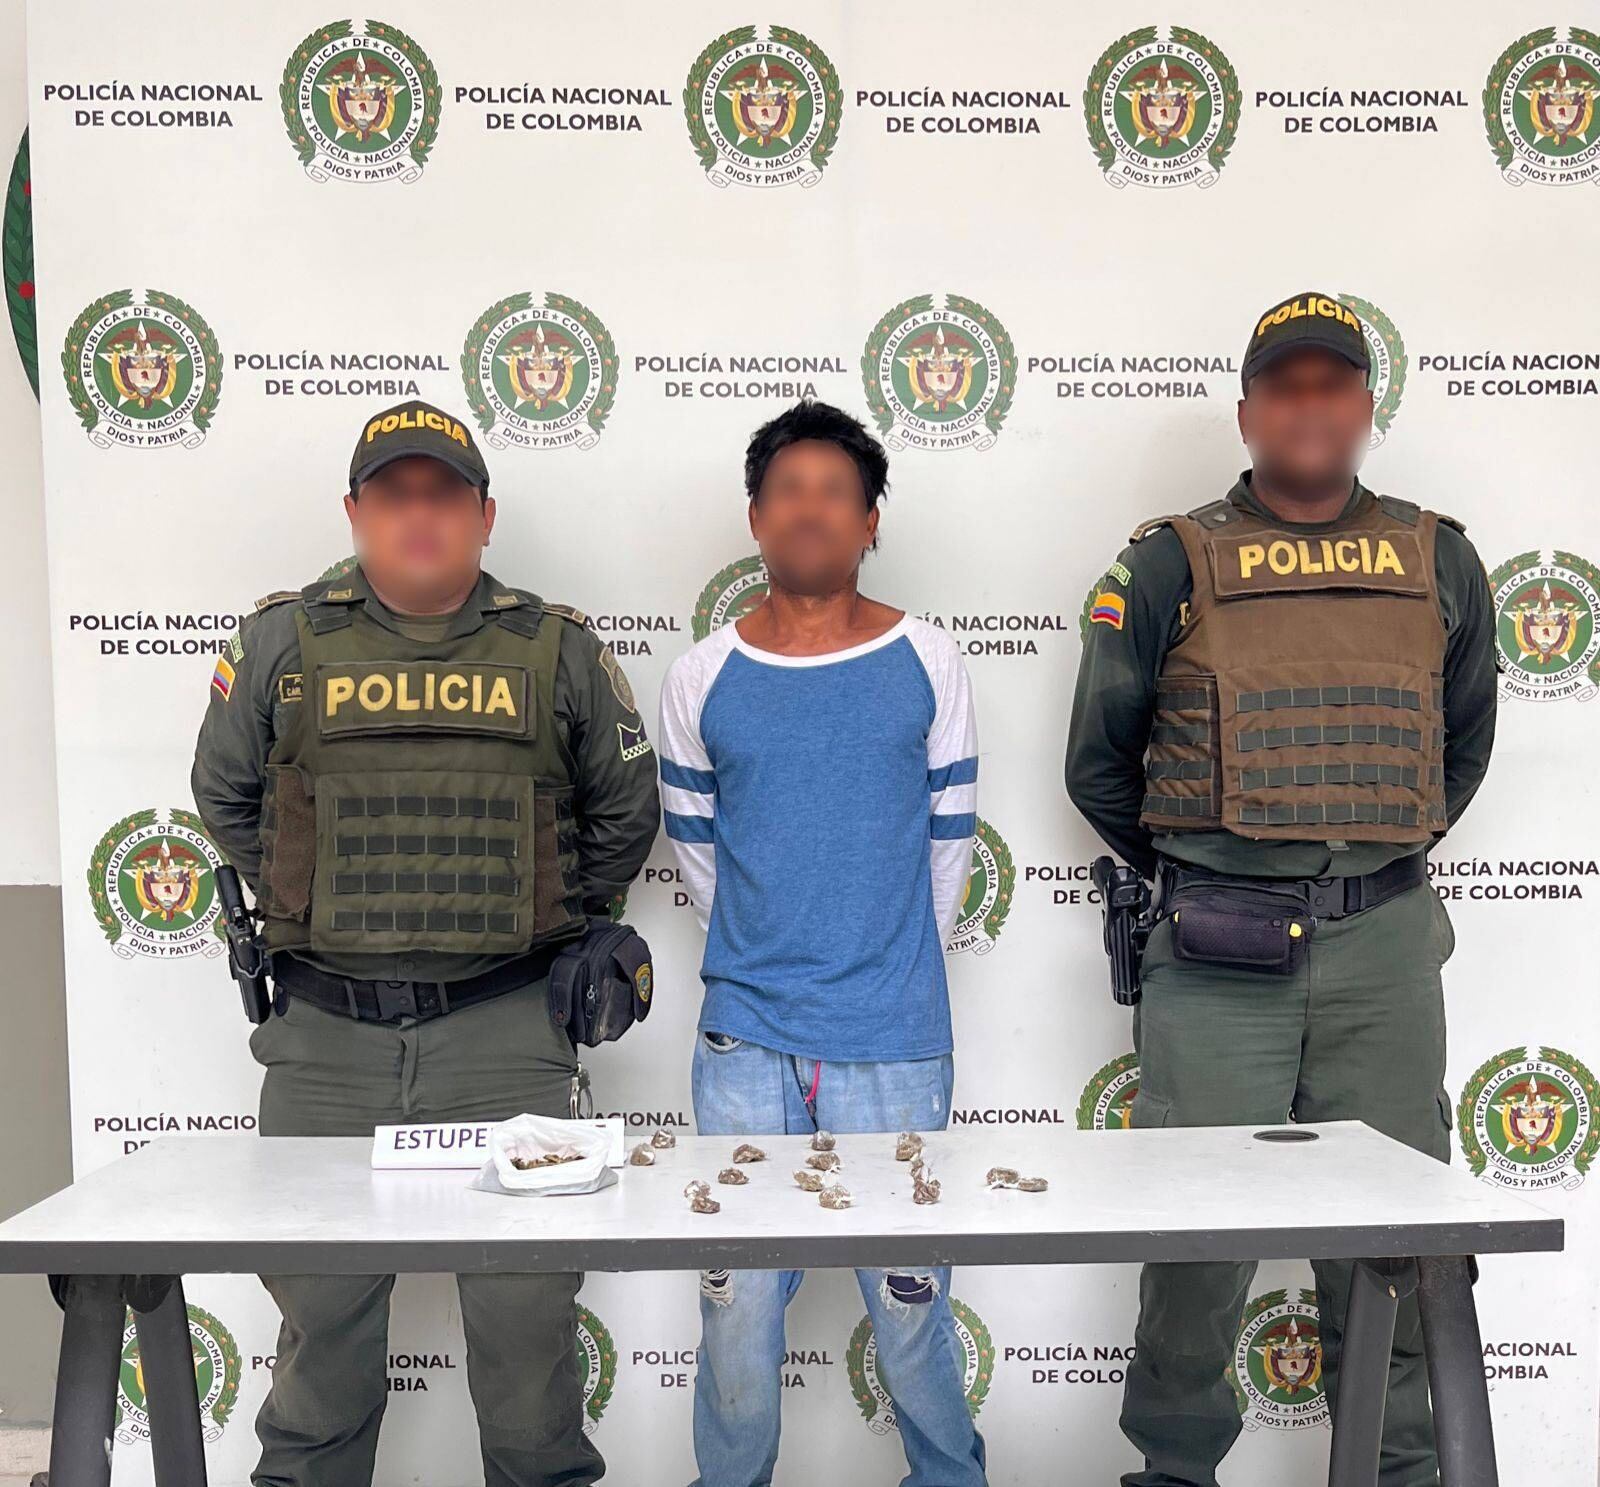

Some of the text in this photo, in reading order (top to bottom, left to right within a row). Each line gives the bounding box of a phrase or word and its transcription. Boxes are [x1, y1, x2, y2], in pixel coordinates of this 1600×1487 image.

[1556, 45, 1571, 53] DE
[353, 39, 369, 47] DE
[384, 46, 422, 111] COLOMBIA
[757, 44, 772, 52] DE
[786, 51, 823, 115] COLOMBIA
[1157, 45, 1173, 53] DE
[1186, 52, 1221, 116] COLOMBIA
[45, 80, 262, 101] POLICÍA NACIONAL
[456, 83, 672, 105] POLICÍA NACIONAL
[857, 87, 1070, 107] POLICÍA NACIONAL
[1256, 87, 1468, 107] POLICÍA NACIONAL
[76, 110, 233, 127] DE COLOMBIA
[487, 114, 642, 131] DE COLOMBIA
[887, 117, 1040, 133] DE COLOMBIA
[1285, 117, 1438, 133] DE COLOMBIA
[365, 127, 417, 163] NACIONAL
[766, 132, 818, 168] NACIONAL
[1163, 132, 1216, 168] NACIONAL
[365, 162, 405, 179] PATRIA
[766, 167, 805, 184] PATRIA
[1163, 167, 1202, 184] PATRIA
[1560, 164, 1599, 182] PATRIA
[1257, 297, 1360, 336] POLICIA
[134, 308, 150, 316] DE
[164, 316, 203, 378] COLOMBIA
[533, 311, 548, 319] DE
[563, 318, 599, 380] COLOMBIA
[934, 312, 949, 320] DE
[963, 320, 998, 381] COLOMBIA
[1361, 324, 1388, 380] OLOMBIA
[235, 350, 449, 371] POLICÍA NACIONAL
[636, 353, 847, 373] POLICÍA NACIONAL
[1029, 354, 1238, 373] POLICÍA NACIONAL
[1419, 351, 1599, 371] POLICÍA NACION
[266, 380, 420, 396] DE COLOMBIA
[666, 382, 817, 398] DE COLOMBIA
[1058, 382, 1208, 398] DE COLOMBIA
[1448, 380, 1598, 396] DE COLOMBIA
[148, 394, 199, 430] NACIONAL
[543, 395, 595, 431] NACIONAL
[941, 396, 993, 432] NACIONAL
[148, 428, 188, 445] PATRIA
[366, 410, 468, 447] POLICIA
[543, 429, 582, 446] PATRIA
[941, 430, 979, 447] PATRIA
[1238, 538, 1405, 578] POLICIA
[1541, 568, 1556, 576] DE
[712, 579, 750, 631] EPUBLICA
[70, 611, 246, 630] POLICÍA NACIO
[586, 616, 680, 631] ACIONAL
[952, 616, 1067, 631] NACIONAL
[101, 640, 129, 654] DE
[1544, 649, 1595, 684] NACIONAL
[326, 673, 517, 717] POLICIA
[1543, 682, 1582, 698] PATRIA
[158, 826, 174, 834] DE
[187, 833, 223, 867] COLOM
[1427, 858, 1600, 876] OLICÍA NACIONA
[1054, 890, 1080, 904] DE
[1437, 885, 1582, 900] DE COLOMBIA
[170, 905, 220, 941] NACIONAL
[170, 939, 208, 955] PATRIA
[947, 935, 978, 951] ATRIA
[1527, 1063, 1542, 1071] DE
[1555, 1070, 1587, 1126] COLOMBIA
[95, 1113, 257, 1132] POLICÍA NACIO
[953, 1109, 1064, 1124] NACIONAL
[393, 1127, 497, 1151] ESTUPE
[1532, 1140, 1582, 1173] NACIONAL
[1531, 1171, 1568, 1187] PATRIA
[579, 1329, 598, 1373] LOMBIA
[1005, 1344, 1087, 1361] POLICÍA
[1483, 1342, 1577, 1357] ACIONAL
[390, 1355, 456, 1369] IONAL
[661, 1374, 687, 1387] DE
[1033, 1370, 1124, 1383] DE COLO
[1485, 1365, 1548, 1379] OMBIA
[872, 1385, 895, 1409] POLI
[1293, 1394, 1326, 1413] NACIO
[1293, 1411, 1330, 1426] PATRIA
[131, 1425, 150, 1437] DIO
